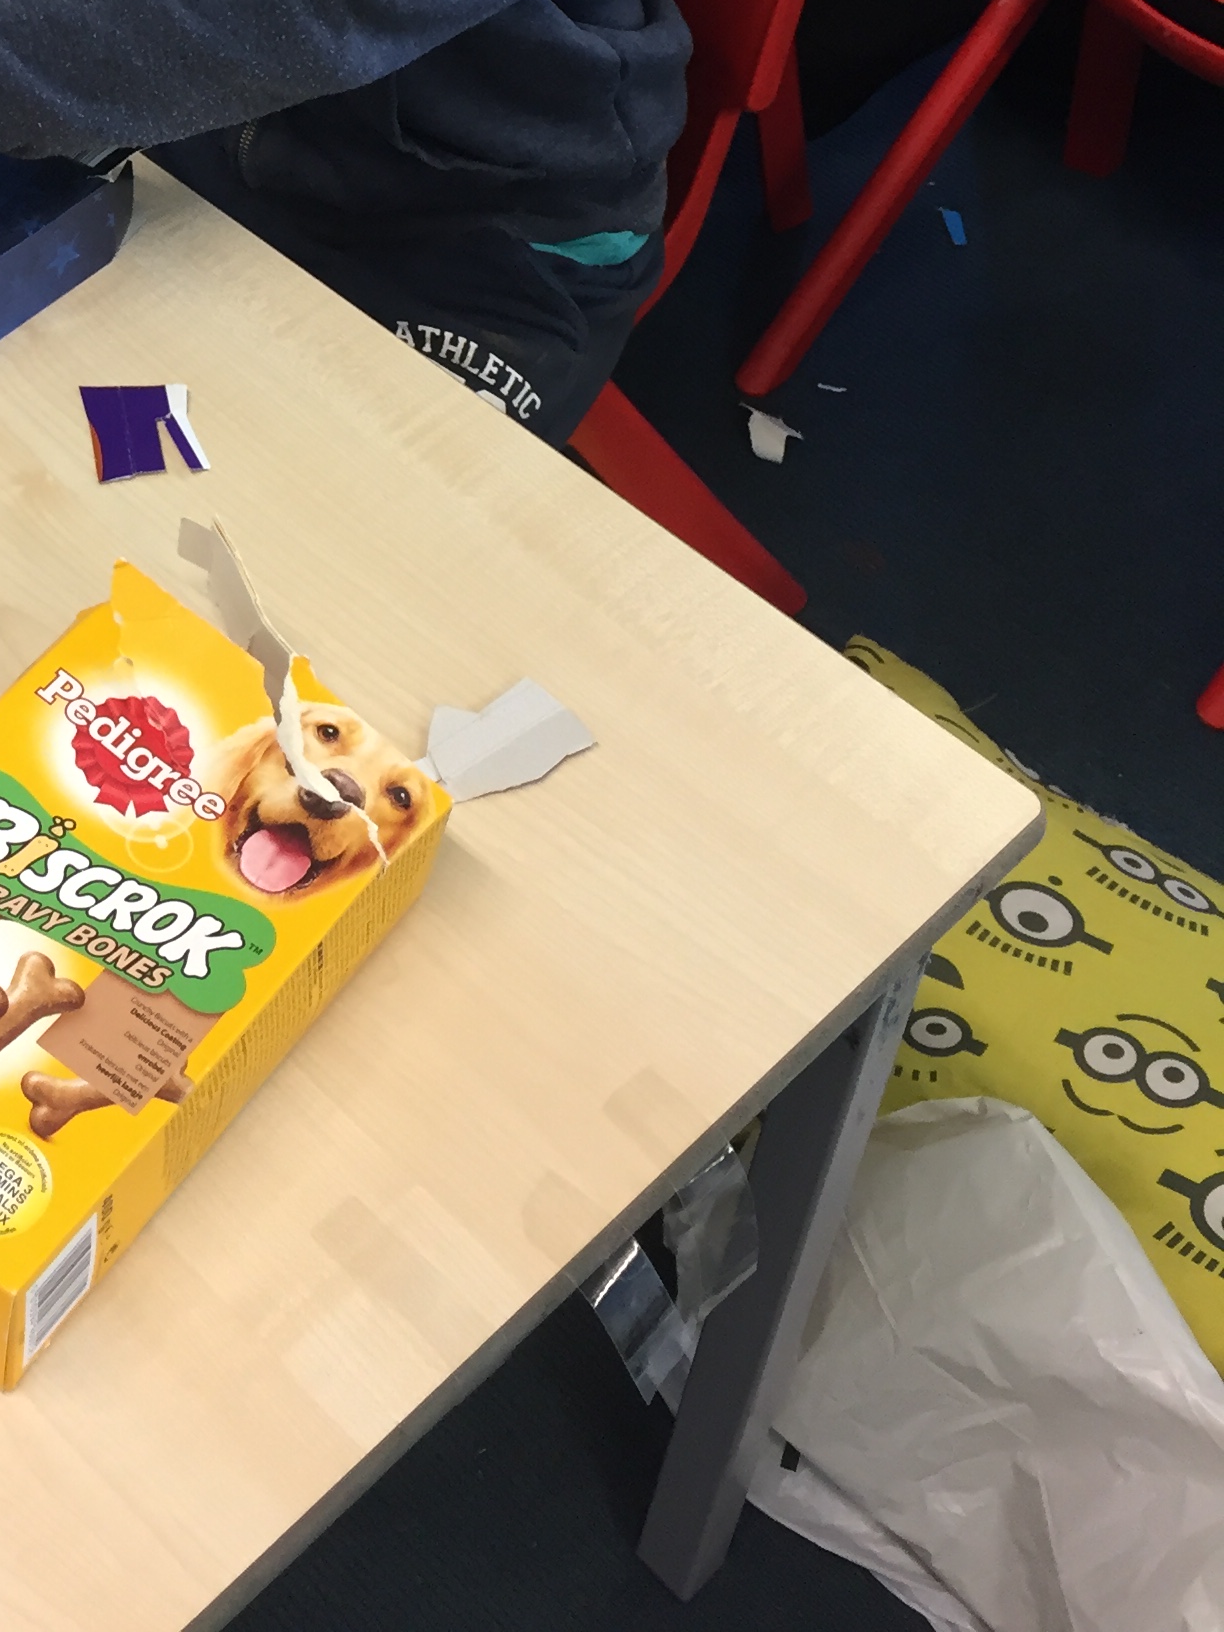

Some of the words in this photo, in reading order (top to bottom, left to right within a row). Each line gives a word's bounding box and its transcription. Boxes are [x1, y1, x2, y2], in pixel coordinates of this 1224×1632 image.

[395, 320, 542, 421] ATHLETIC
[36, 667, 227, 820] Pedigree
[63, 923, 174, 988] BONES
[130, 1007, 161, 1033] Delicious
[160, 1028, 187, 1052] Coating
[24, 1184, 34, 1195] 3
